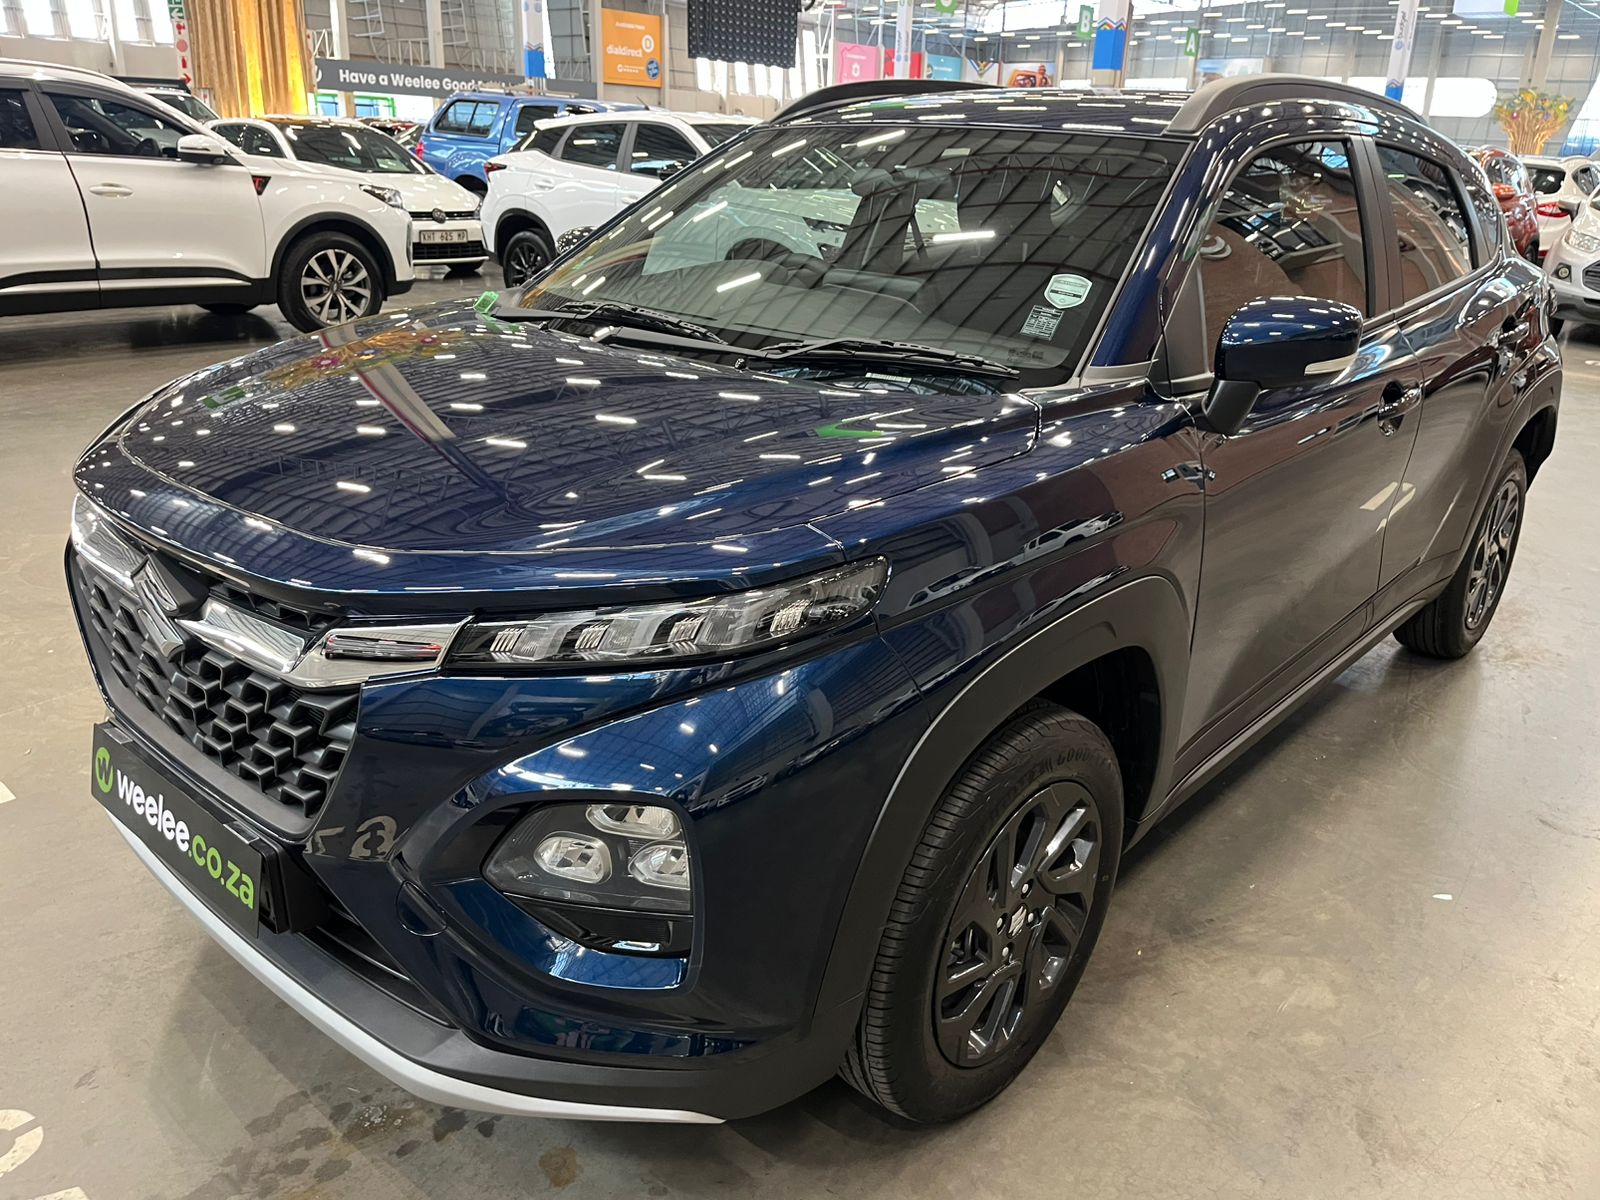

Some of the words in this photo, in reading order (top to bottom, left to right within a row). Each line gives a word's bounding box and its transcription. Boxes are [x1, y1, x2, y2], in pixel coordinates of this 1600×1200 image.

[1187, 32, 1196, 53] A
[339, 69, 376, 84] Have
[379, 75, 388, 86] a
[390, 73, 440, 90] Weelee
[442, 78, 474, 91] Good
[117, 769, 255, 910] weelee.co.za
